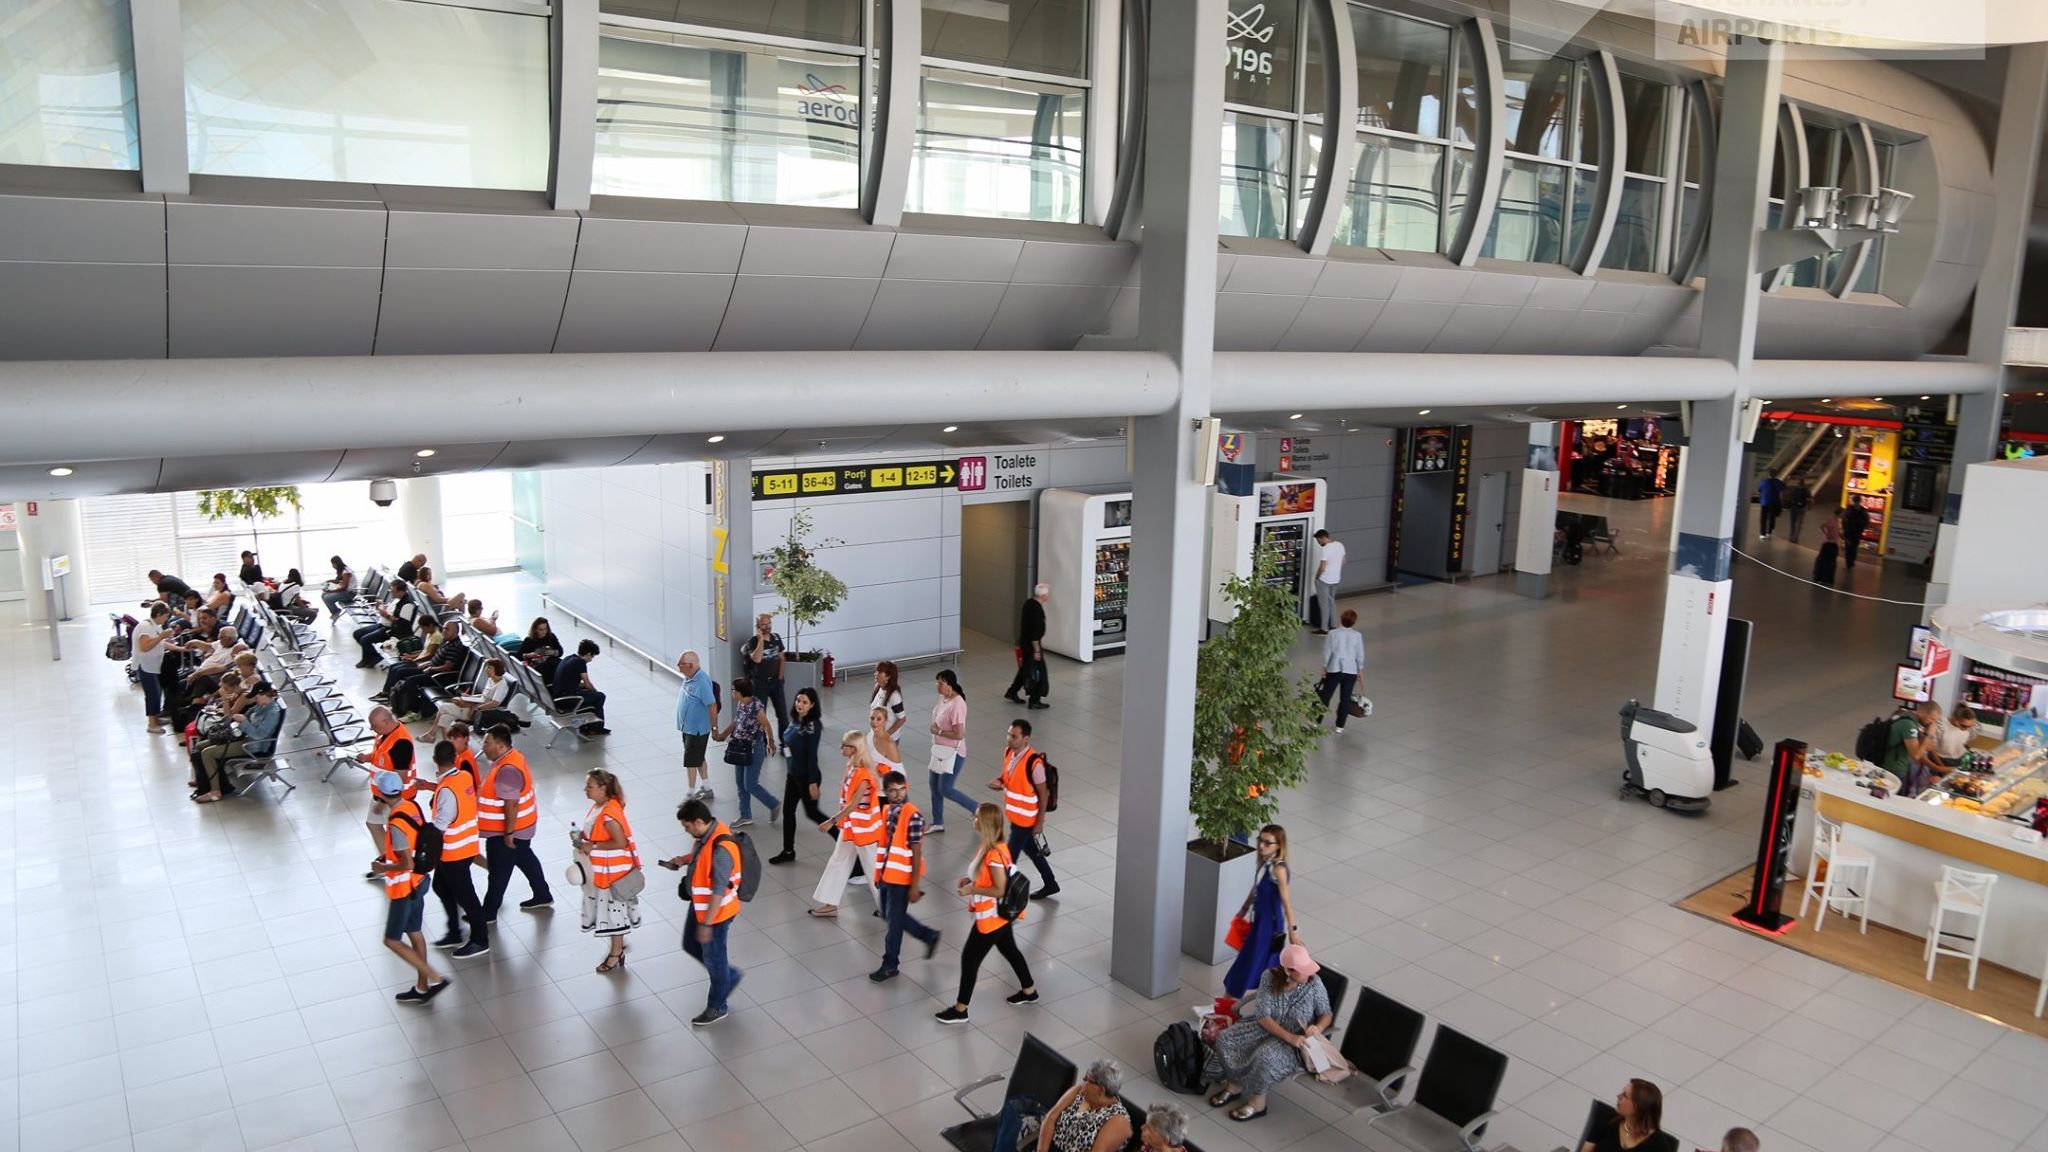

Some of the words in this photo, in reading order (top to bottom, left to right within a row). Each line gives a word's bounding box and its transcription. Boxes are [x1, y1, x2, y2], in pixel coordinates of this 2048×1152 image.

[994, 454, 1037, 470] Toalete
[769, 478, 794, 490] 5-11
[803, 475, 836, 488] 36-43
[879, 472, 896, 483] 1-4
[906, 469, 935, 482] 12-15
[994, 474, 1033, 490] Toilets
[1455, 493, 1465, 506] Z
[1452, 514, 1463, 559] SLOTS
